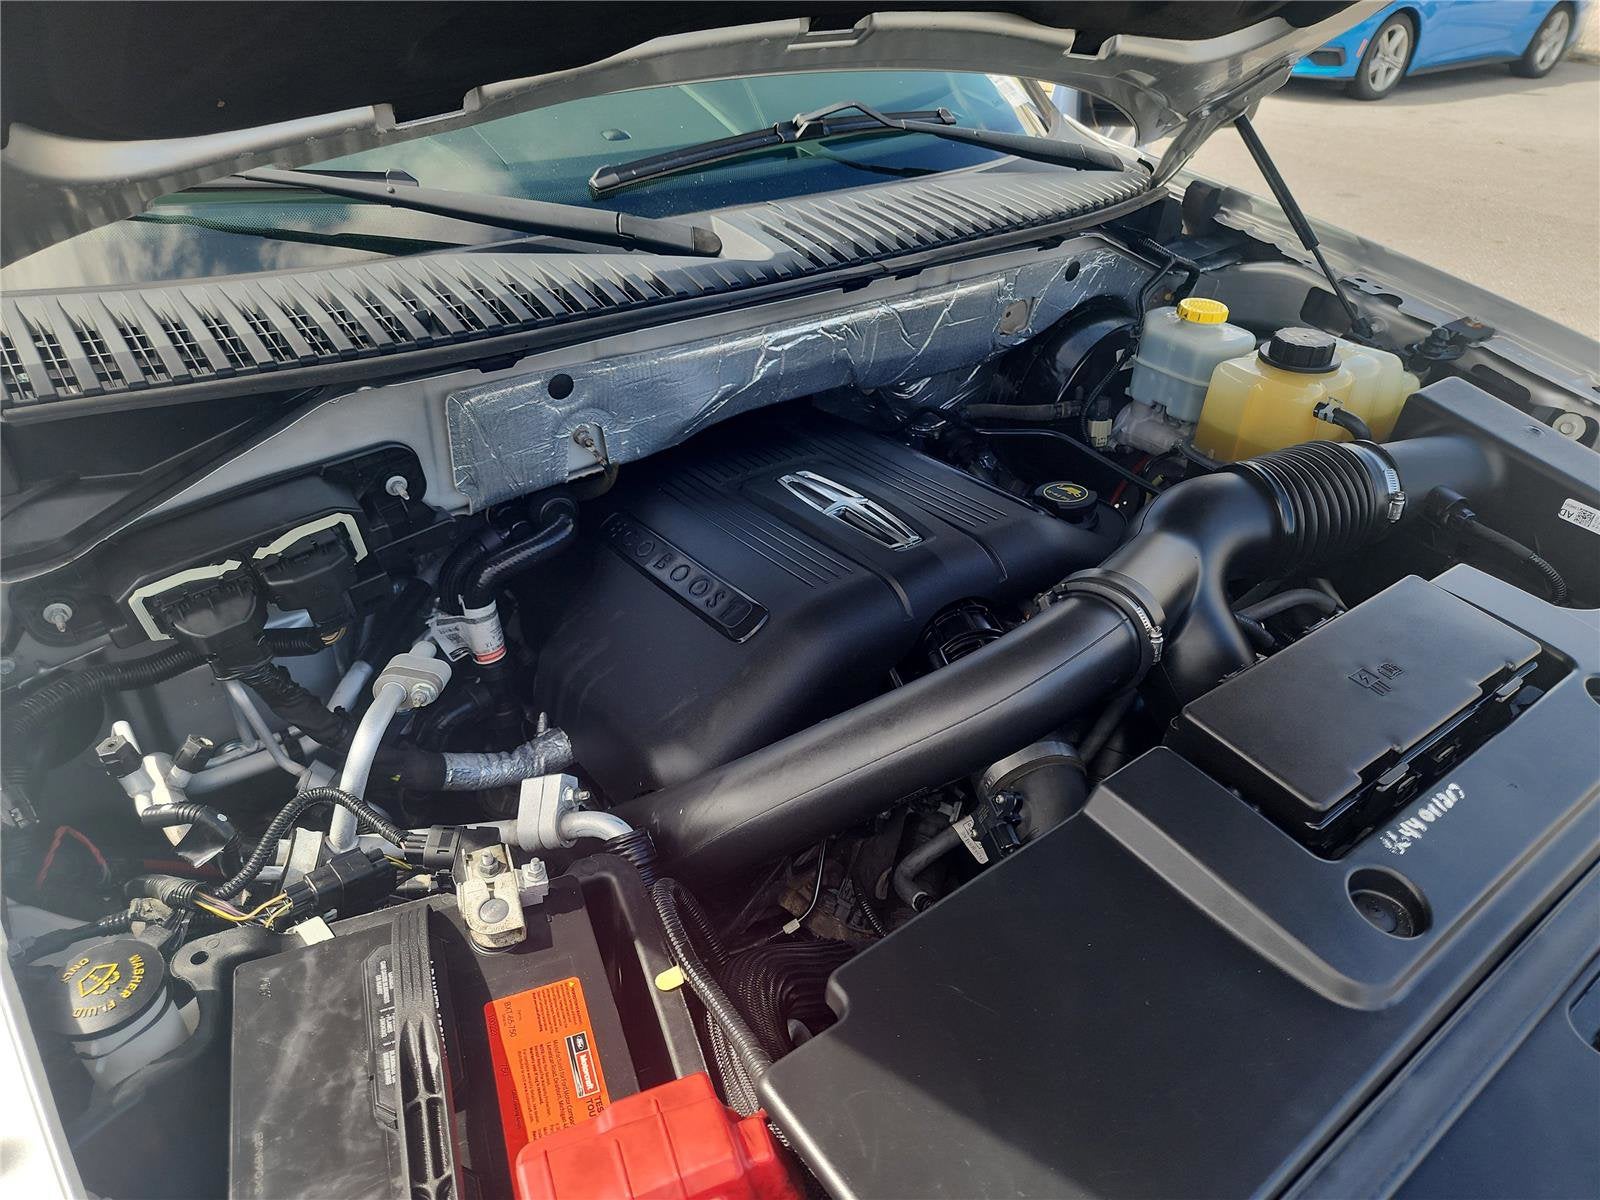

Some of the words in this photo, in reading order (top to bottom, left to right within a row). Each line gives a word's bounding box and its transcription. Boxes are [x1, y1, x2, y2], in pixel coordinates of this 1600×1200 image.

[120, 954, 144, 999] WASHER
[580, 1054, 594, 1091] Motorcraft
[586, 1098, 597, 1118] TOU
[595, 1095, 605, 1113] TES
